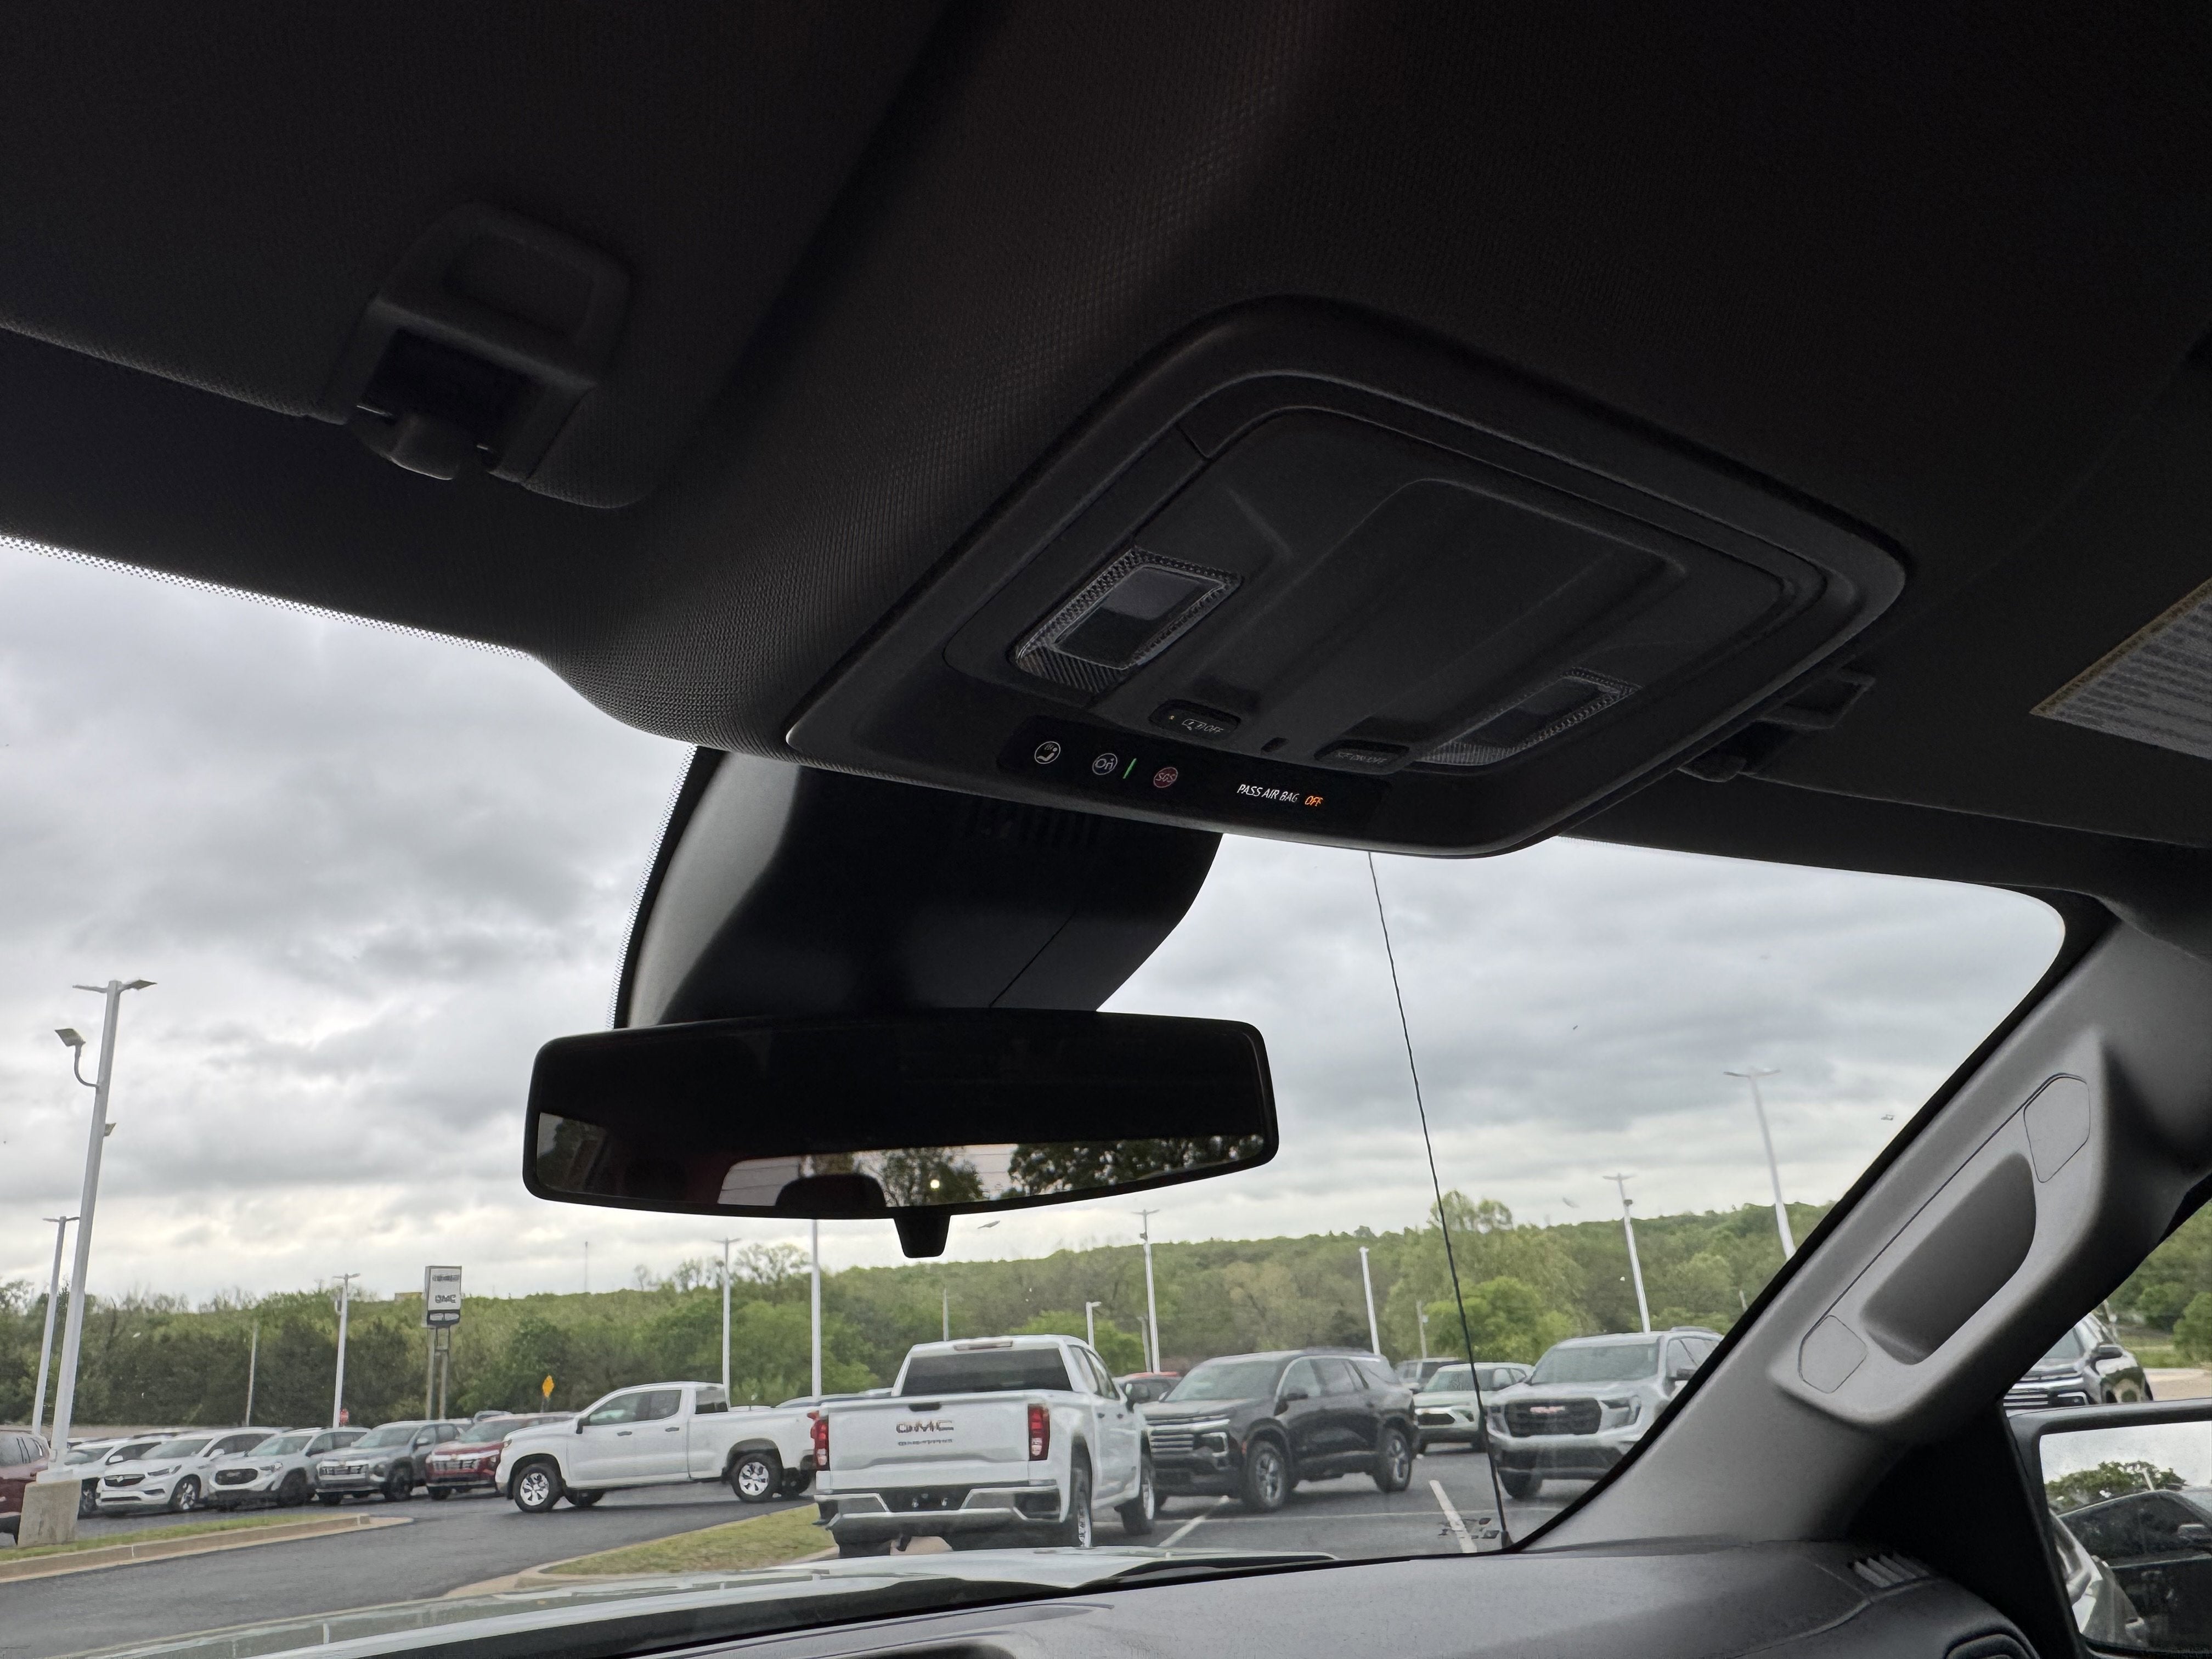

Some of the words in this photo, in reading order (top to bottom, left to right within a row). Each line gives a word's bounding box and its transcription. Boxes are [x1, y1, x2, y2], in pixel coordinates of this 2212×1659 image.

[1237, 784, 1263, 797] PASS
[1261, 788, 1280, 799] AIR
[1279, 792, 1299, 803] BAG
[1305, 795, 1324, 806] OFF
[896, 1420, 954, 1433] GMC
